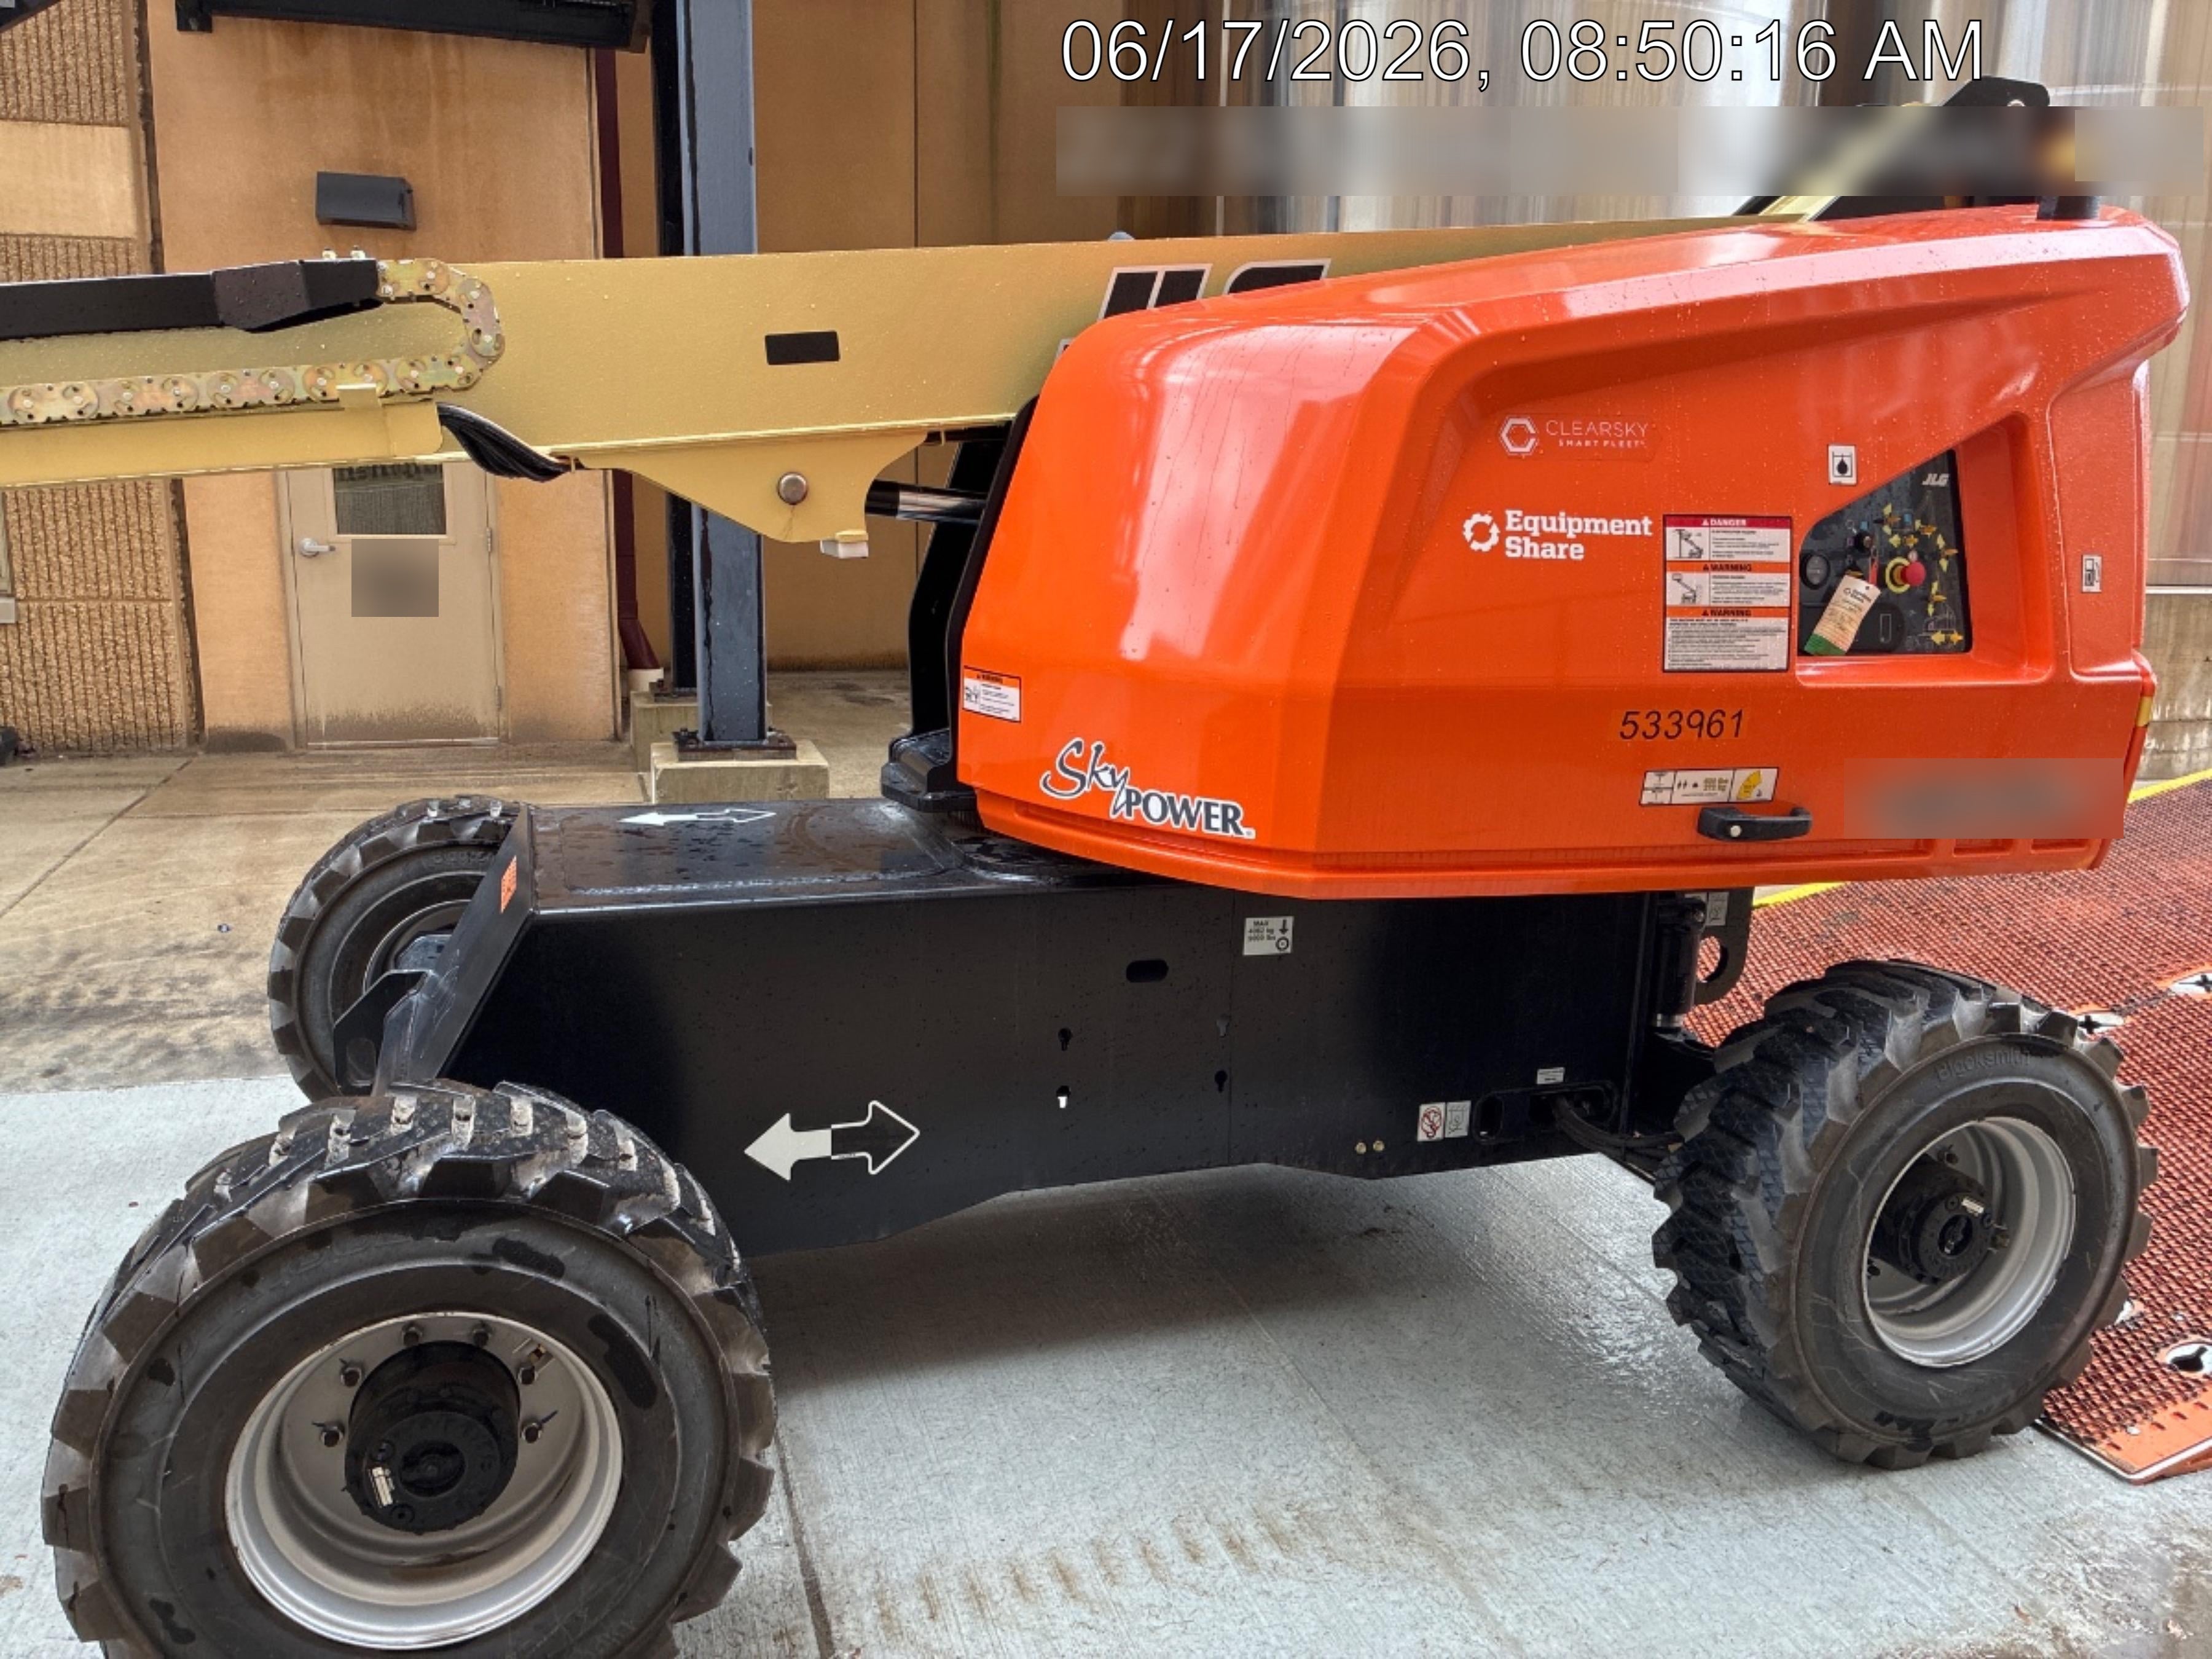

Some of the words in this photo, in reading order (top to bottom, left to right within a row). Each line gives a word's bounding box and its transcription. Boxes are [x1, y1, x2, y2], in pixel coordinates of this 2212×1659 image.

[1546, 420, 1649, 437] CLEARSKY
[1922, 473, 1949, 486] JLG
[1505, 509, 1653, 538] Equipment
[1505, 535, 1585, 560] Share
[1619, 708, 1744, 739] 533961
